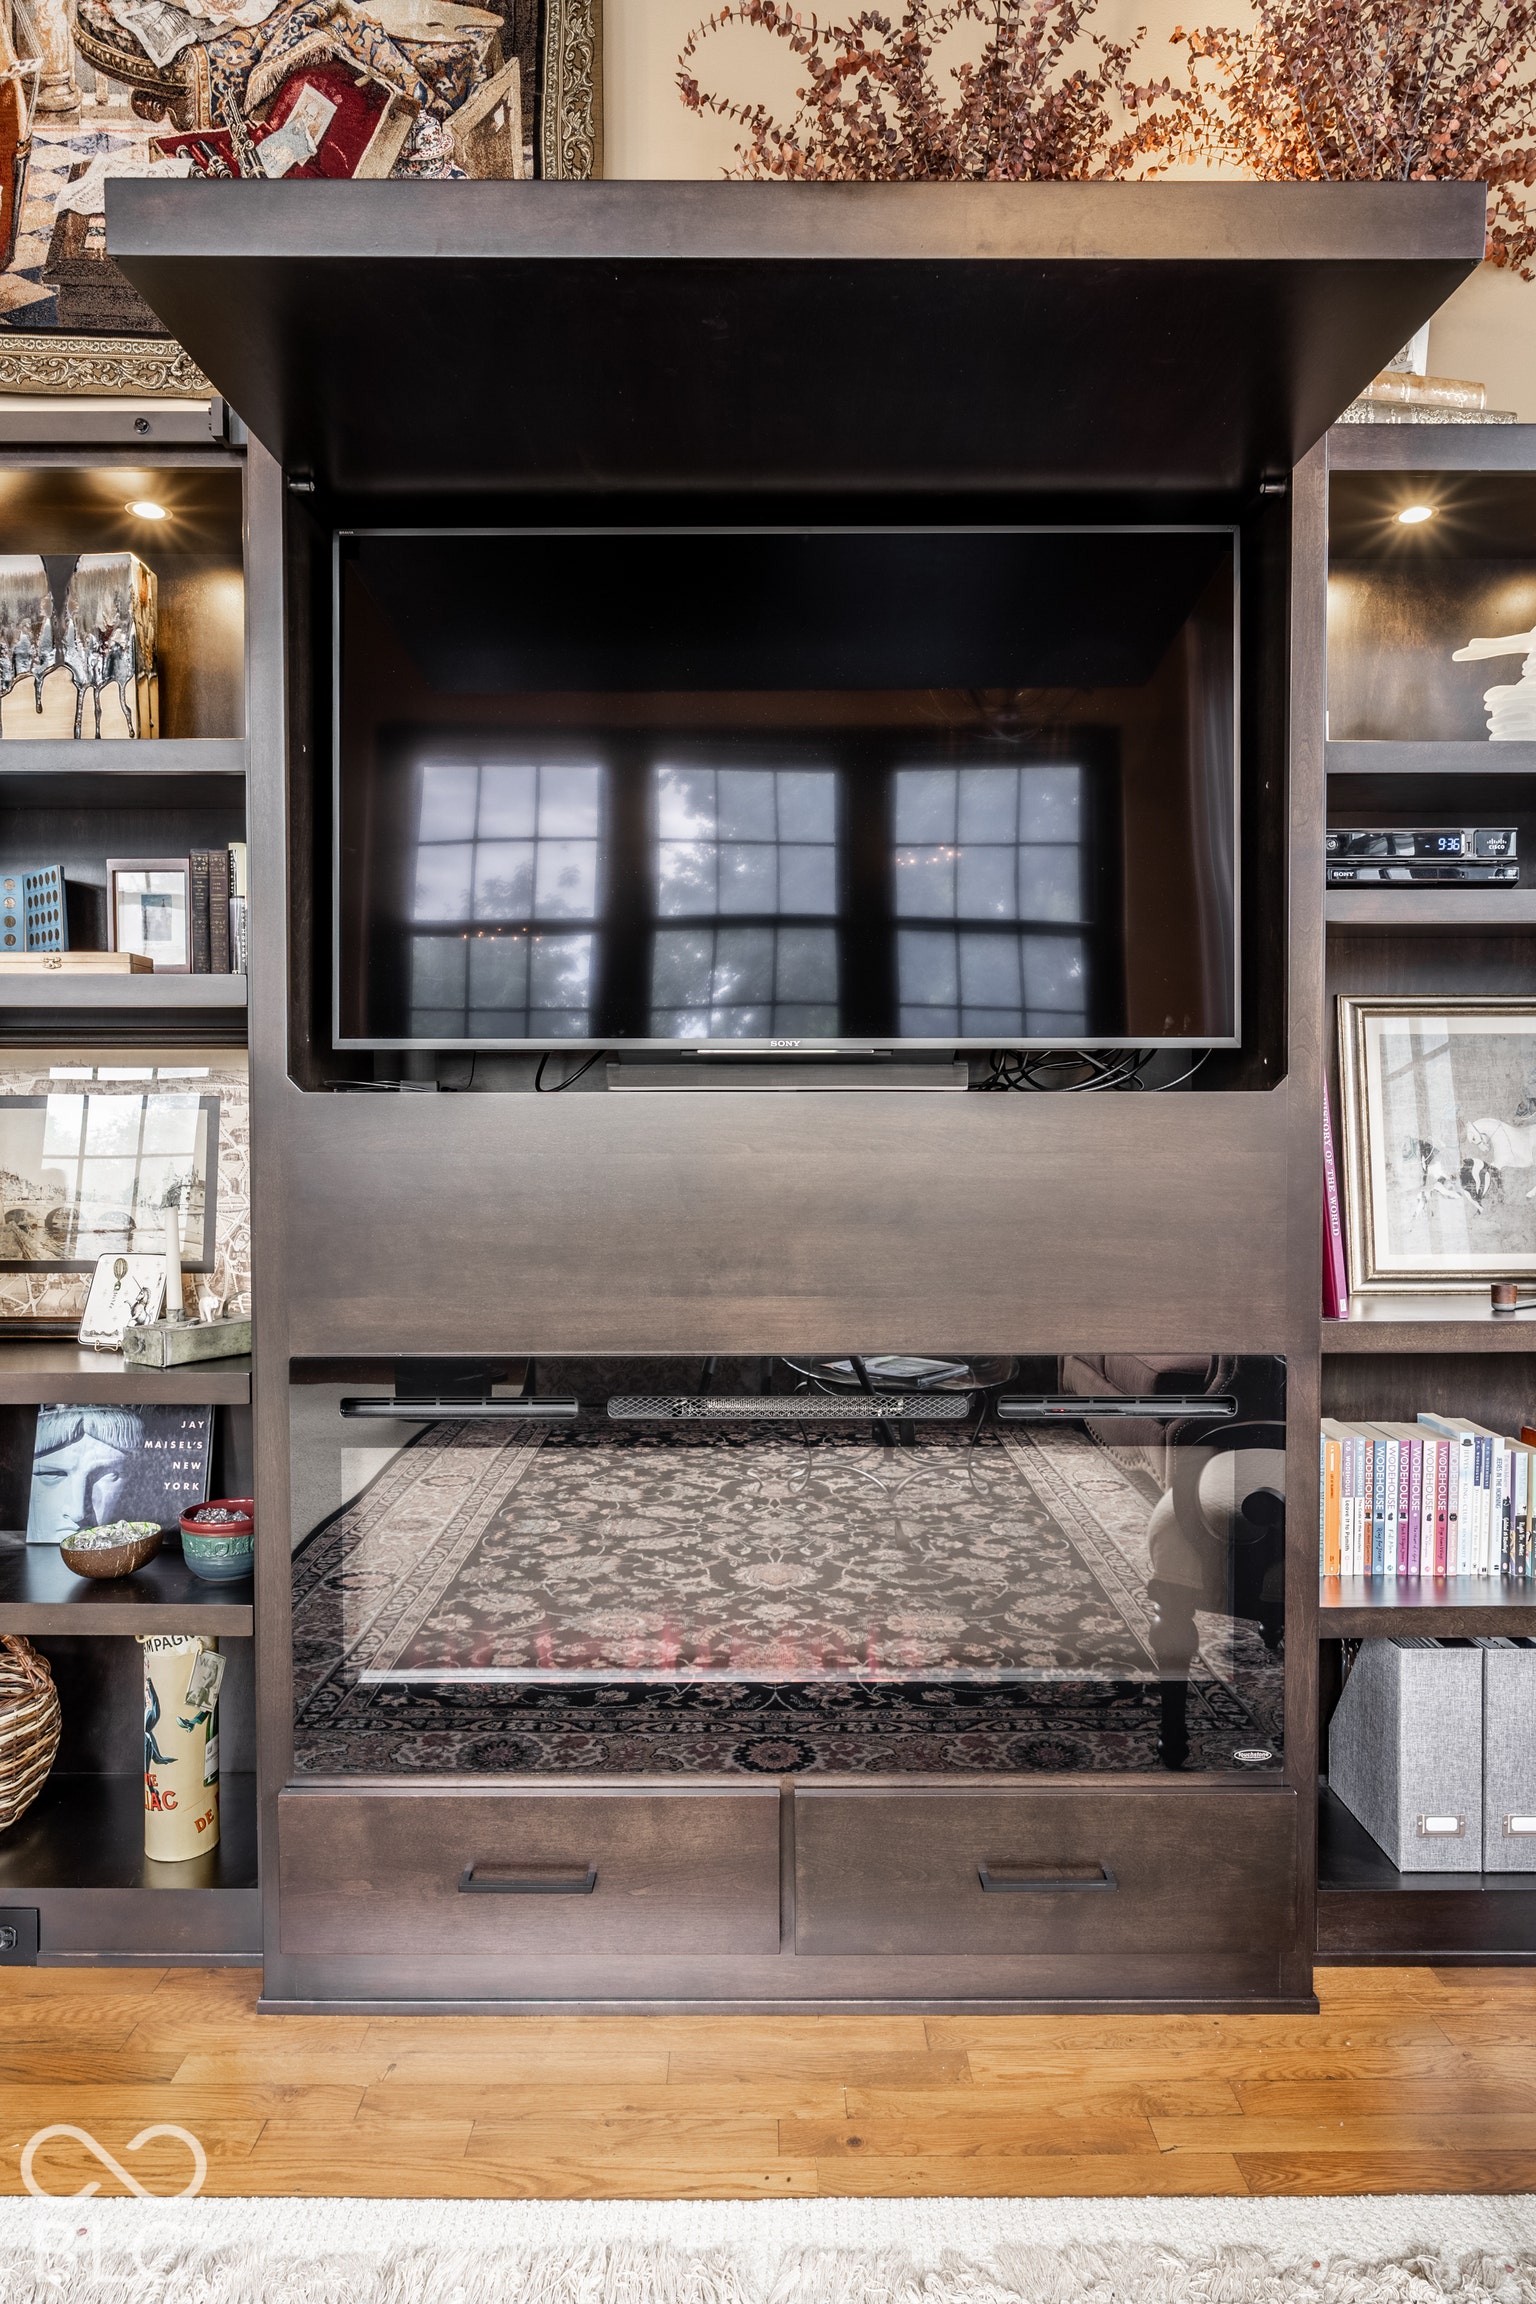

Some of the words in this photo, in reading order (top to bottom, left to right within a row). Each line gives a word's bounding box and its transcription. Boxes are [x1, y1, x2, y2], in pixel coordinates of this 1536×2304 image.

[1325, 1150, 1333, 1165] OF
[1327, 1170, 1335, 1192] THE
[1330, 1197, 1340, 1236] WORLD
[164, 1482, 199, 1490] YORK
[173, 1462, 201, 1470] NEW
[1365, 1446, 1373, 1509] WODEHOUSE
[1376, 1447, 1384, 1509] WODEHOUSE
[1388, 1446, 1396, 1509] WODEHOUSE
[1399, 1446, 1408, 1509] WODEHOUSE
[1412, 1447, 1421, 1510] WODEHOUSE
[1425, 1447, 1434, 1510] WODEHOUSE
[1438, 1447, 1447, 1510] WODEHOUSE
[1449, 1446, 1458, 1510] WODEHOUSE
[1375, 1528, 1383, 1539] Ring
[194, 1809, 214, 1833] DE
